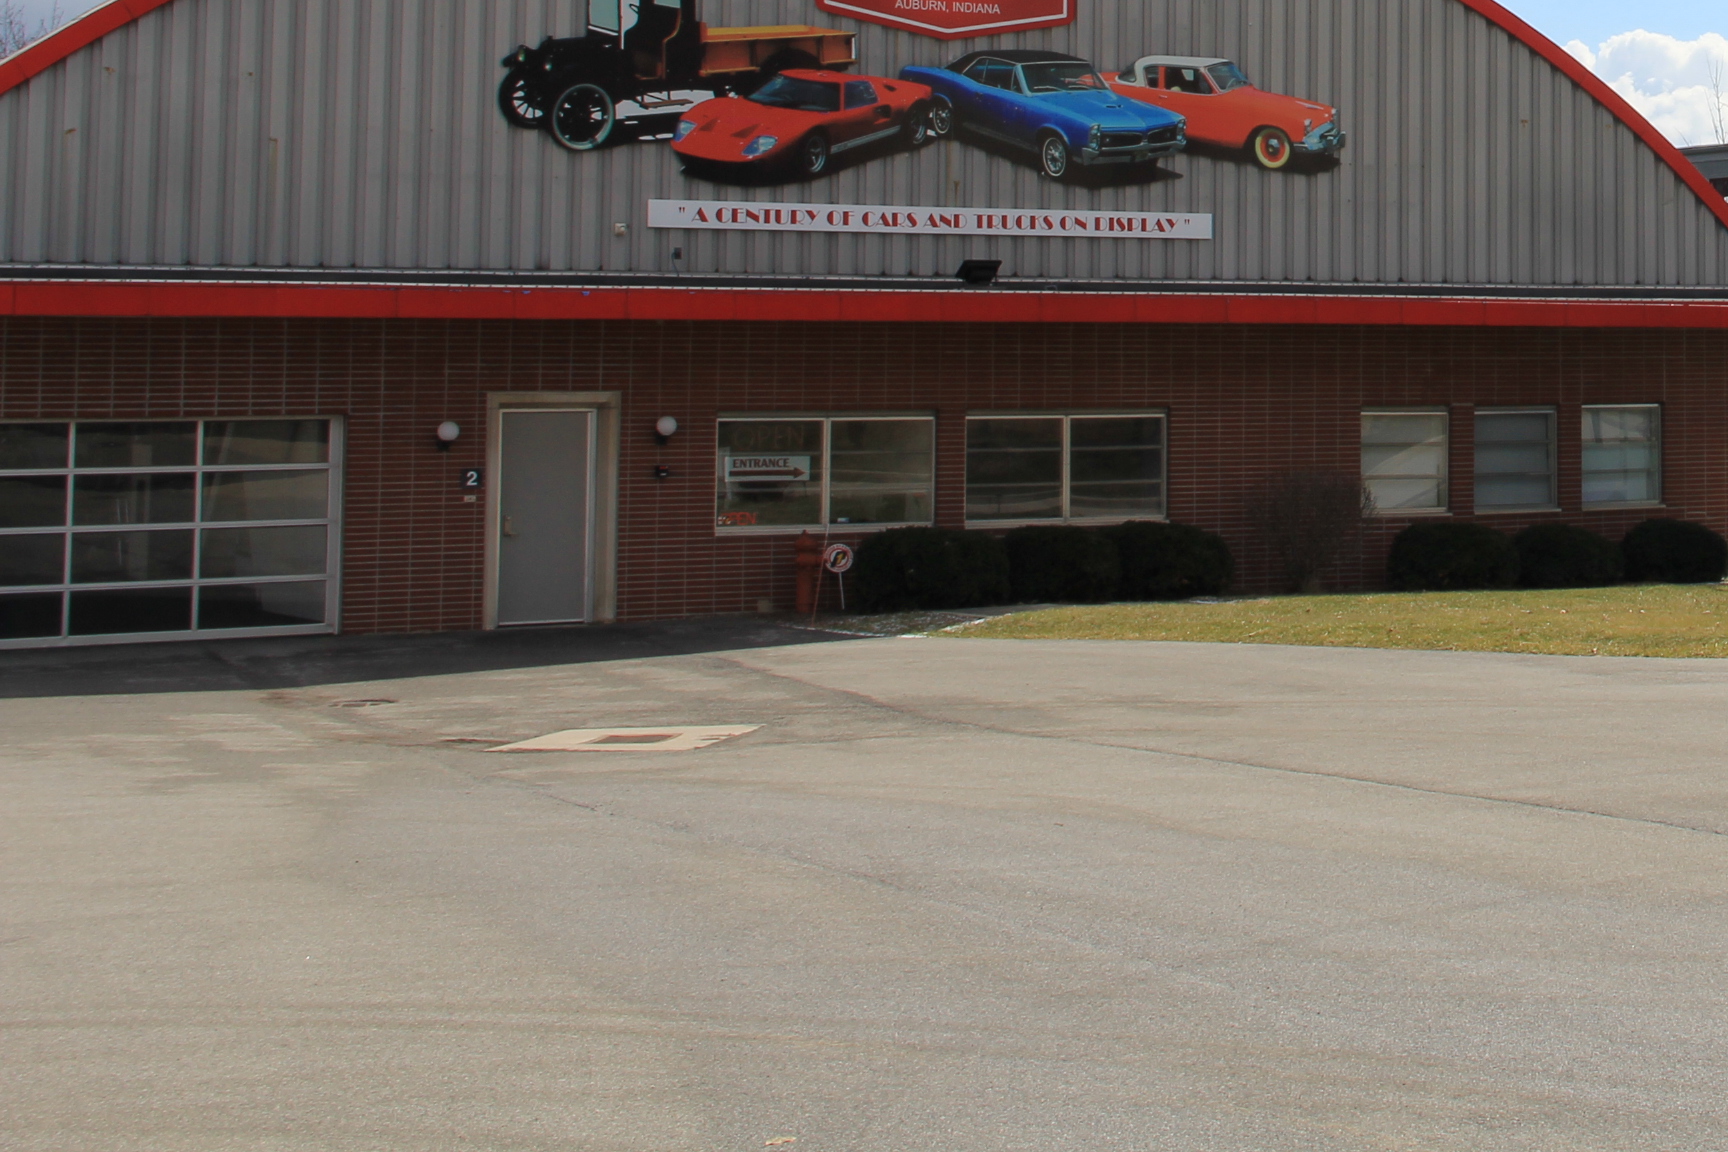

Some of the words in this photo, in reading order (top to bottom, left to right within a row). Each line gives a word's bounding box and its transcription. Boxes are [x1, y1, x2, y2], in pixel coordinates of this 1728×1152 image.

[953, 1, 1001, 15] INDIANA
[691, 207, 709, 222] A
[715, 207, 821, 225] CENTURY
[826, 210, 855, 226] OF
[862, 211, 919, 228] CARS
[923, 213, 967, 229] AND
[973, 214, 1054, 230] TRUCKS
[1060, 215, 1087, 231] ON
[1094, 216, 1180, 233] DISPLAY
[732, 458, 790, 469] ENTRANCE
[466, 471, 478, 486] 2
